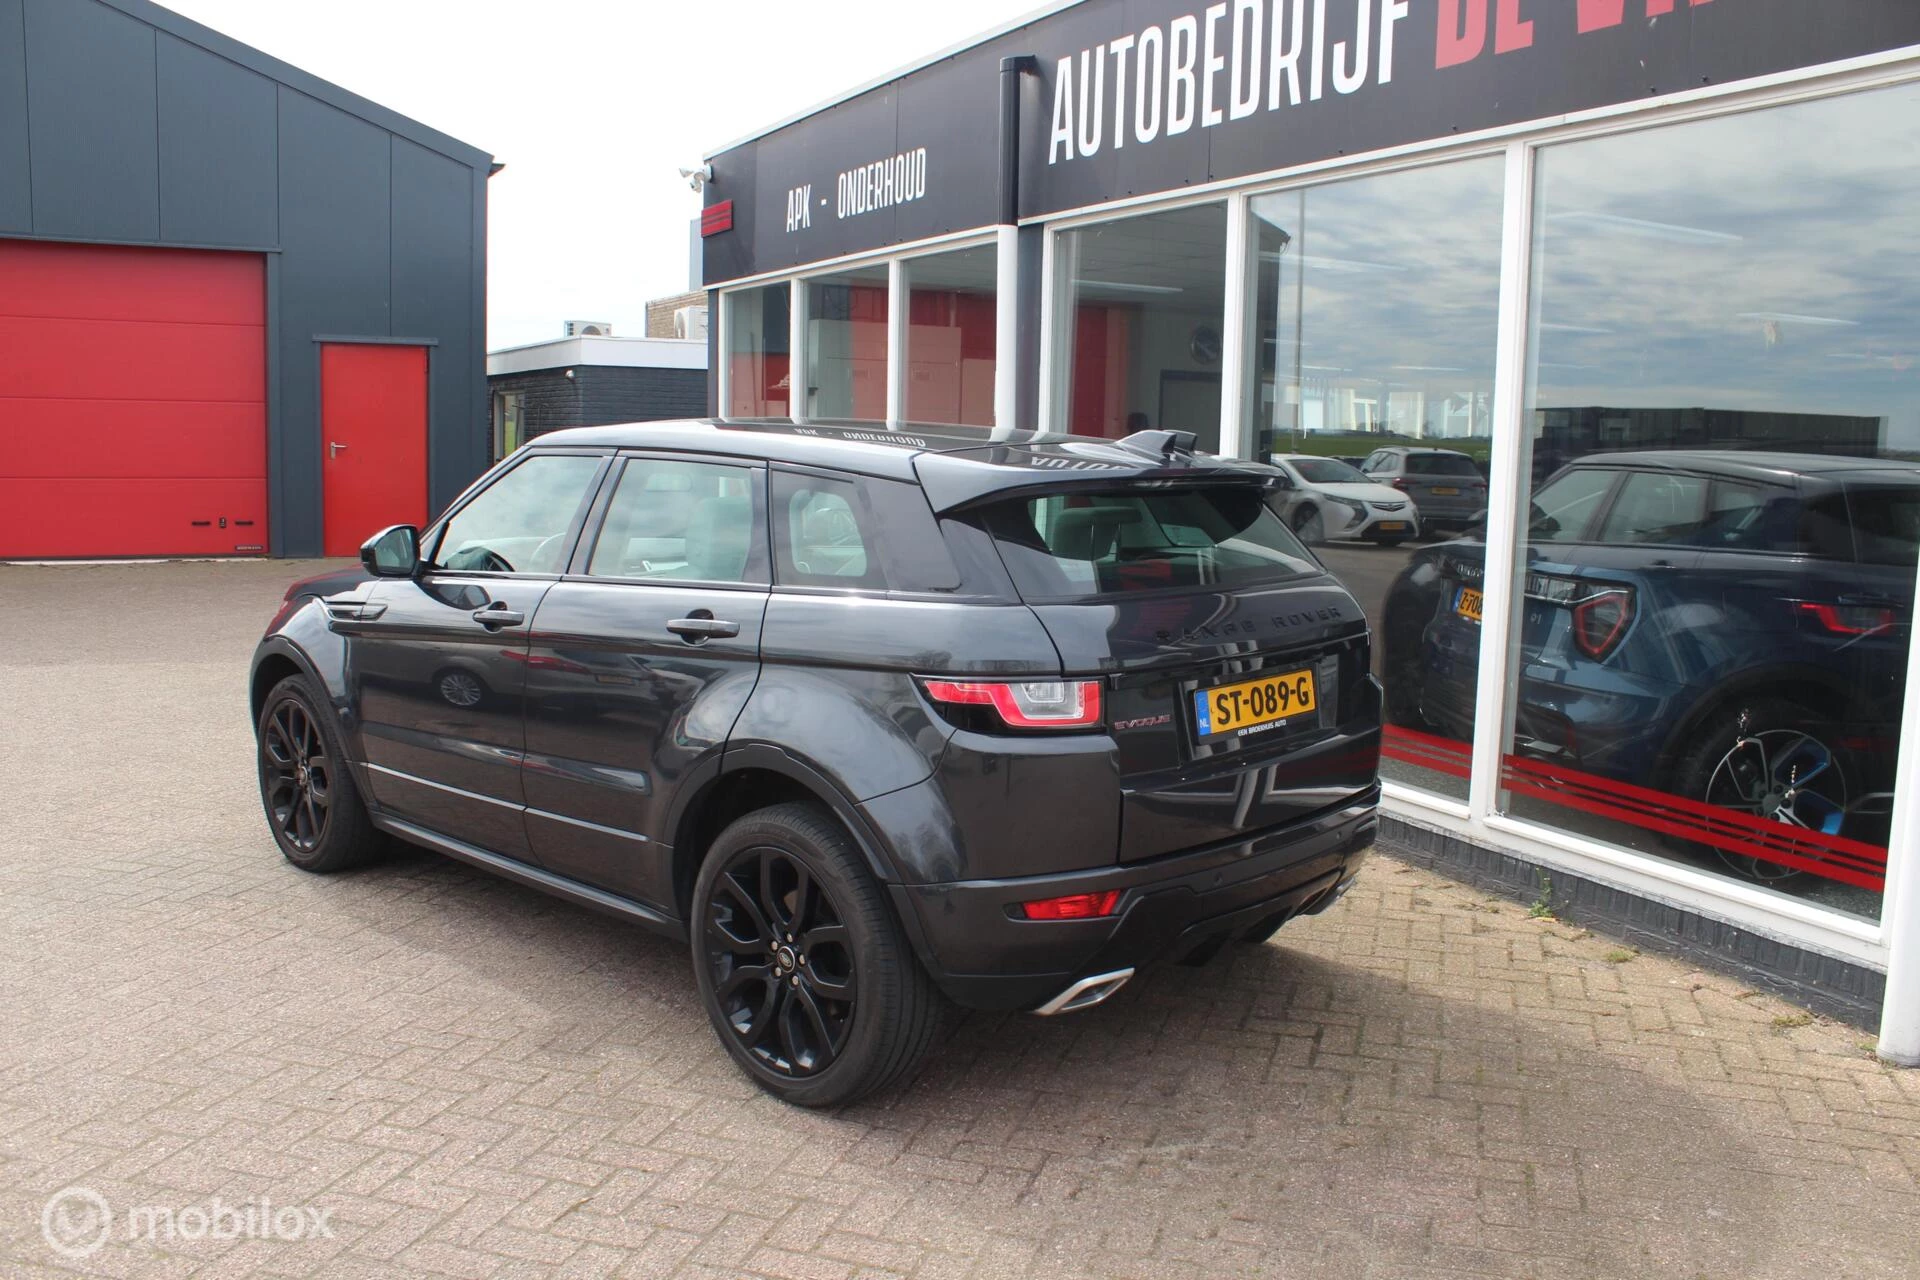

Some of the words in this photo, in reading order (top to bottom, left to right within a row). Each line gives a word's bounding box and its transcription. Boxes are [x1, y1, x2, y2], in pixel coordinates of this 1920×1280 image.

[1048, 0, 1408, 165] AUTOBEDRIJF
[786, 184, 811, 232] APK
[838, 148, 926, 219] ONDERHOUD
[1271, 606, 1342, 628] ROVER
[1216, 677, 1310, 725] ST-089-G
[1114, 714, 1171, 730] EVOQUE
[1199, 718, 1209, 729] NL
